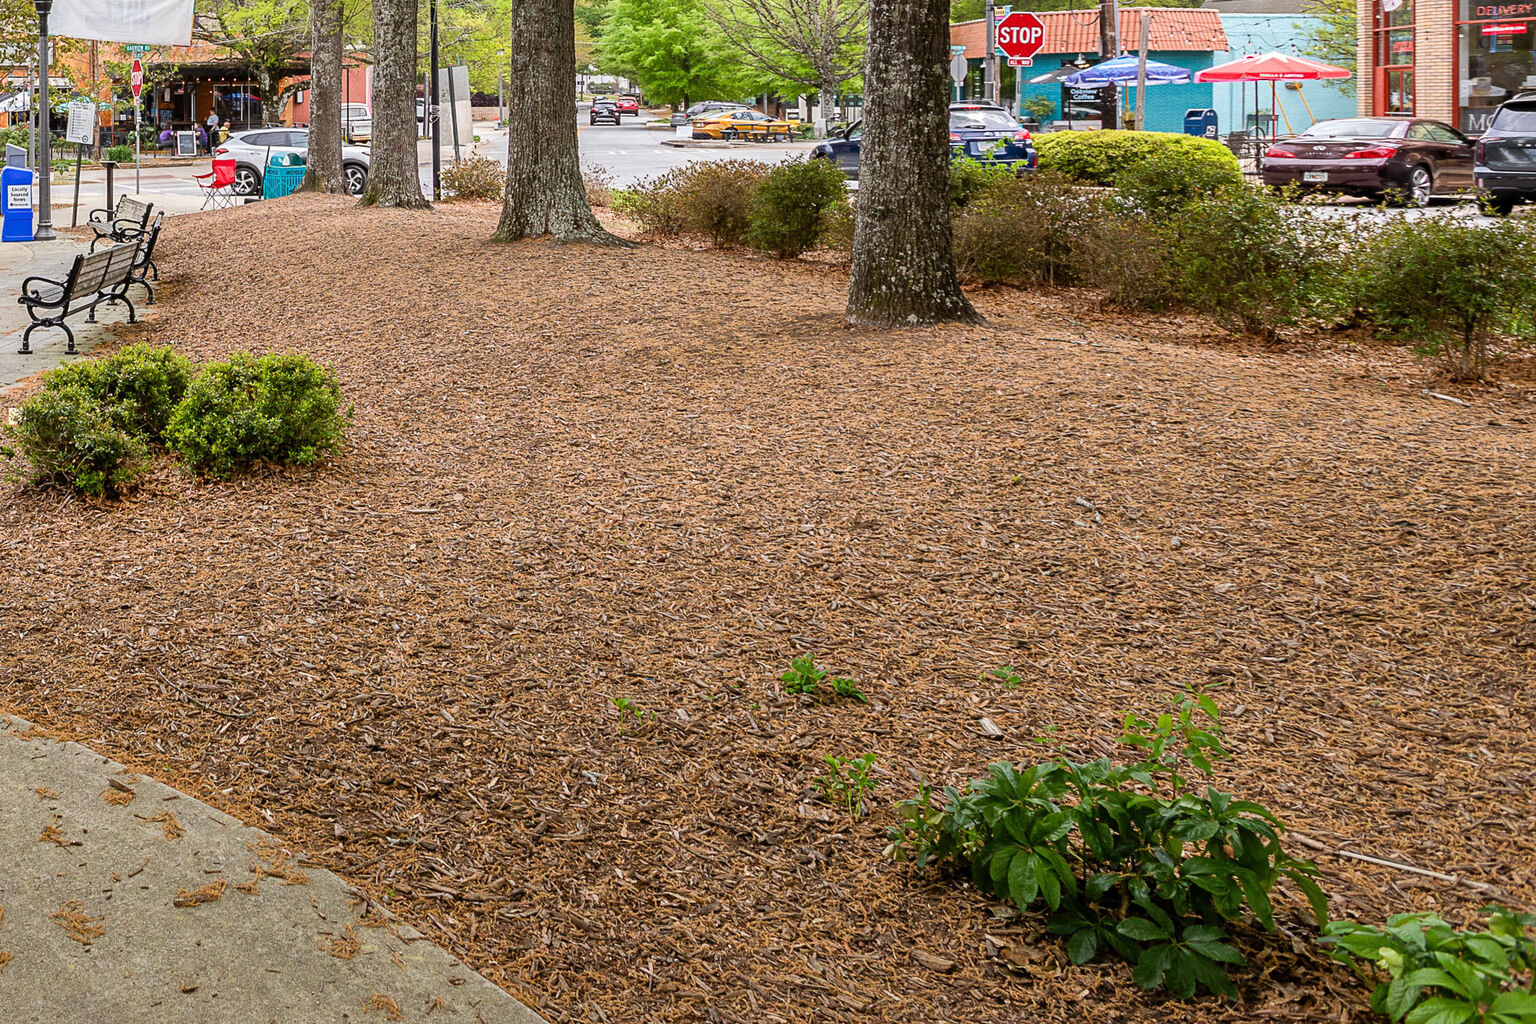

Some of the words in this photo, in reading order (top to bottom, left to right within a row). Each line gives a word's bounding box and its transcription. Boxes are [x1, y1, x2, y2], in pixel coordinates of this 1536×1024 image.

[1477, 4, 1533, 16] DELIVERY
[999, 26, 1042, 44] STOP
[131, 71, 143, 86] STOP
